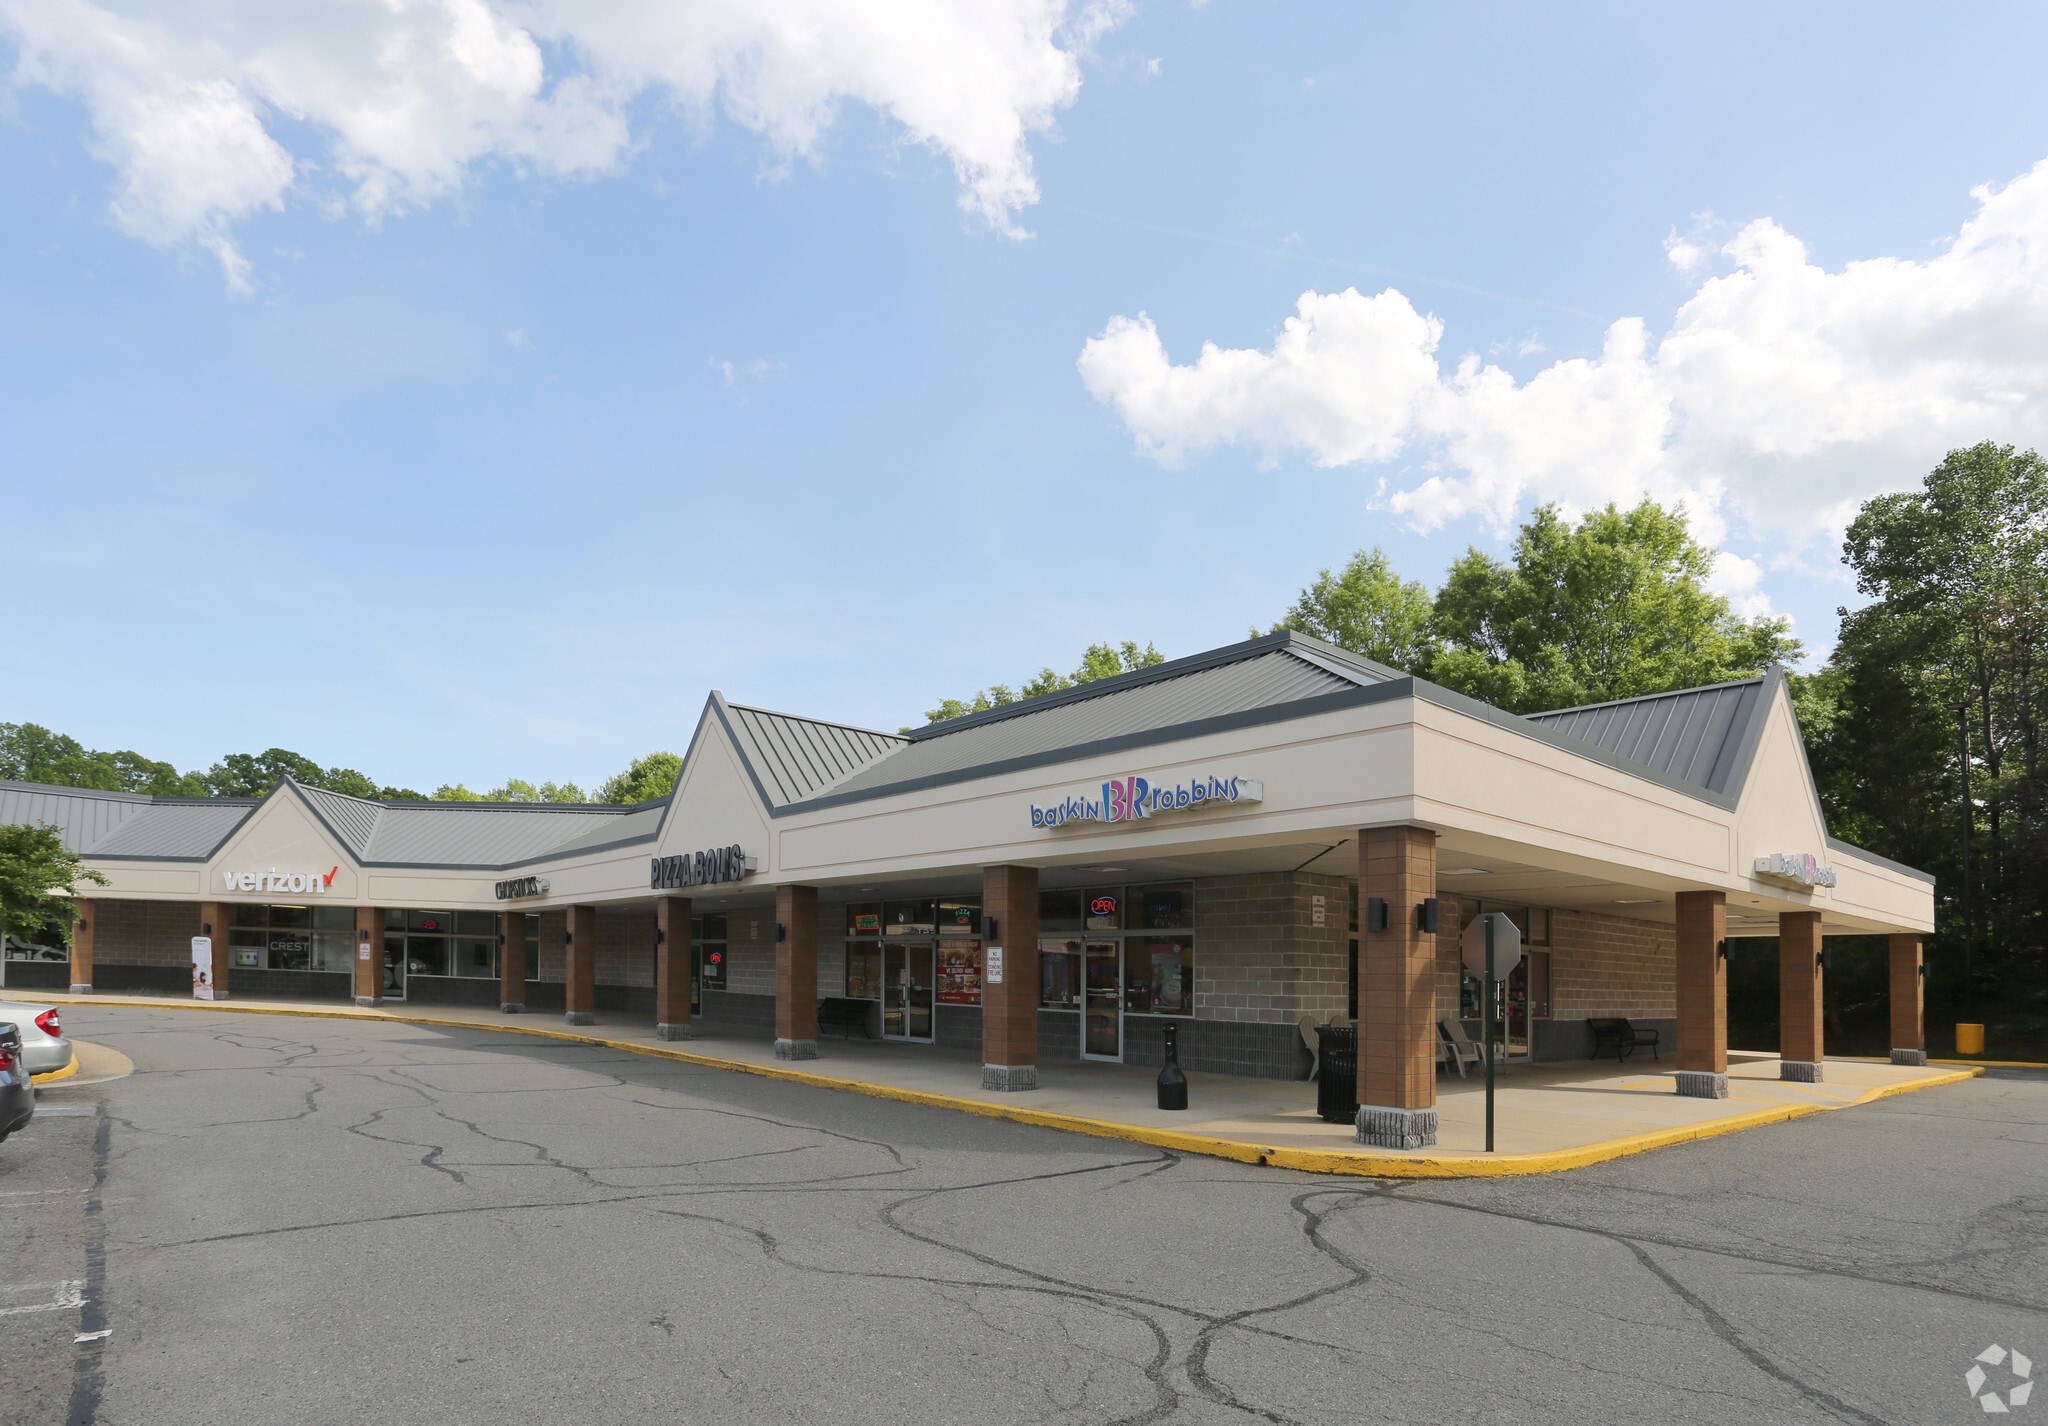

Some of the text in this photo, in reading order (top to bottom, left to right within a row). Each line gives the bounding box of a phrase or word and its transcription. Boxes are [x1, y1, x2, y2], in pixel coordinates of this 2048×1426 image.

[1030, 796, 1099, 828] baskin
[1151, 775, 1240, 811] robbins
[223, 866, 326, 893] verizon
[651, 854, 692, 889] PIZZA
[1091, 899, 1117, 912] OPEN
[270, 942, 309, 951] CREST
